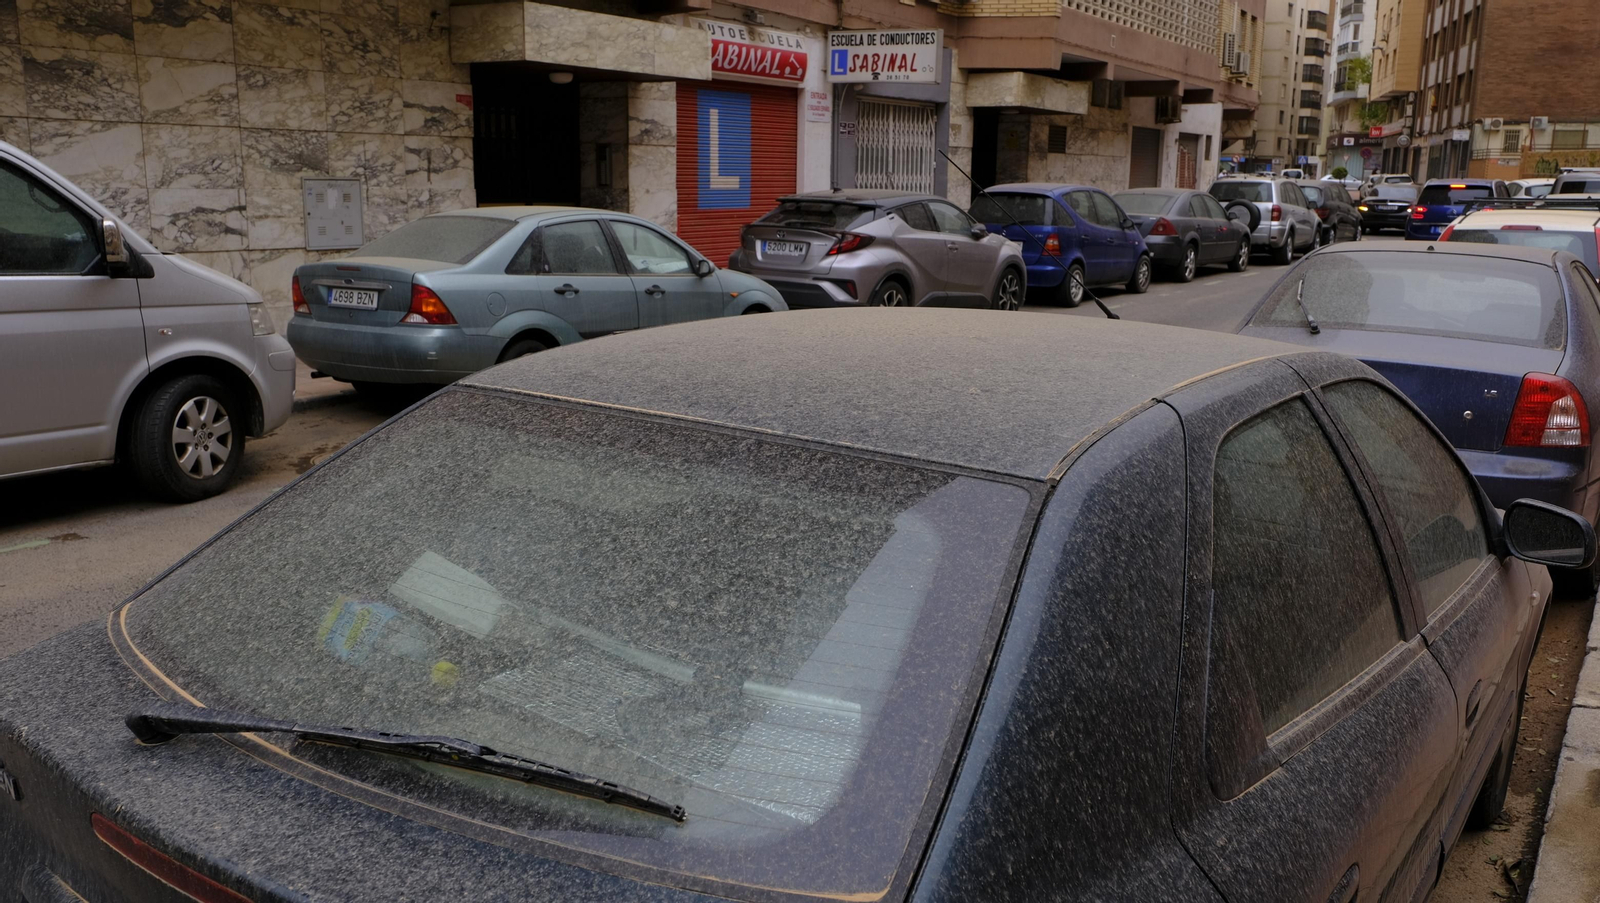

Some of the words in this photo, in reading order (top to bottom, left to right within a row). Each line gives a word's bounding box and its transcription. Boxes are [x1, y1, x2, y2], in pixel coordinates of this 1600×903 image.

[831, 34, 864, 46] ESCUELA
[867, 34, 877, 46] DE
[880, 32, 936, 45] CONDUCTORES
[710, 43, 781, 75] ABINAL
[834, 52, 844, 72] L
[849, 52, 918, 73] SABINAL
[710, 109, 739, 188] L
[767, 242, 787, 252] 5200
[333, 290, 354, 304] 4698
[356, 291, 375, 306] BZN
